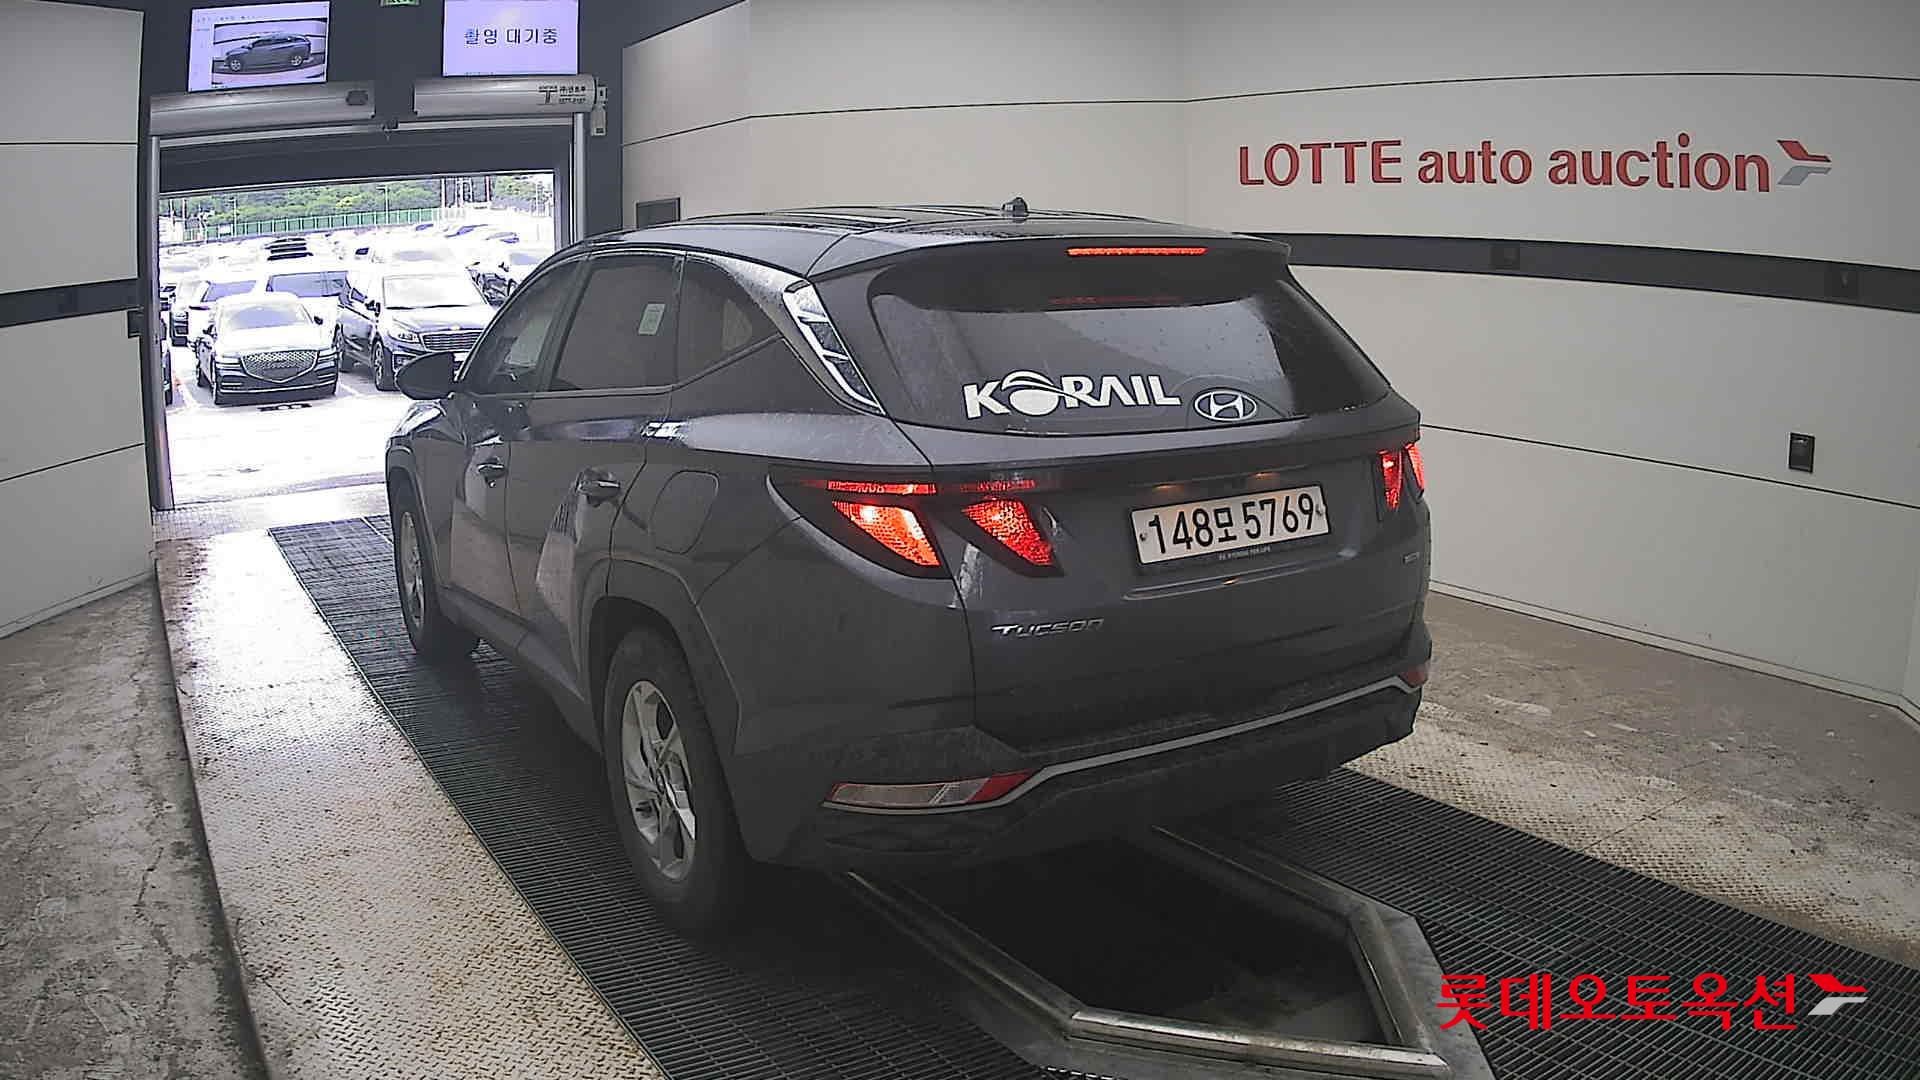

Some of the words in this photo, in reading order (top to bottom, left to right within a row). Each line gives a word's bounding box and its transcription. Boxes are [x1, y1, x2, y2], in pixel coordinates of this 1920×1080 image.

[506, 27, 558, 45] 대기중
[1239, 140, 1402, 186] LOTTE
[1418, 140, 1532, 184] auto
[1548, 132, 1770, 193] auction
[963, 370, 1181, 419] KORAIL
